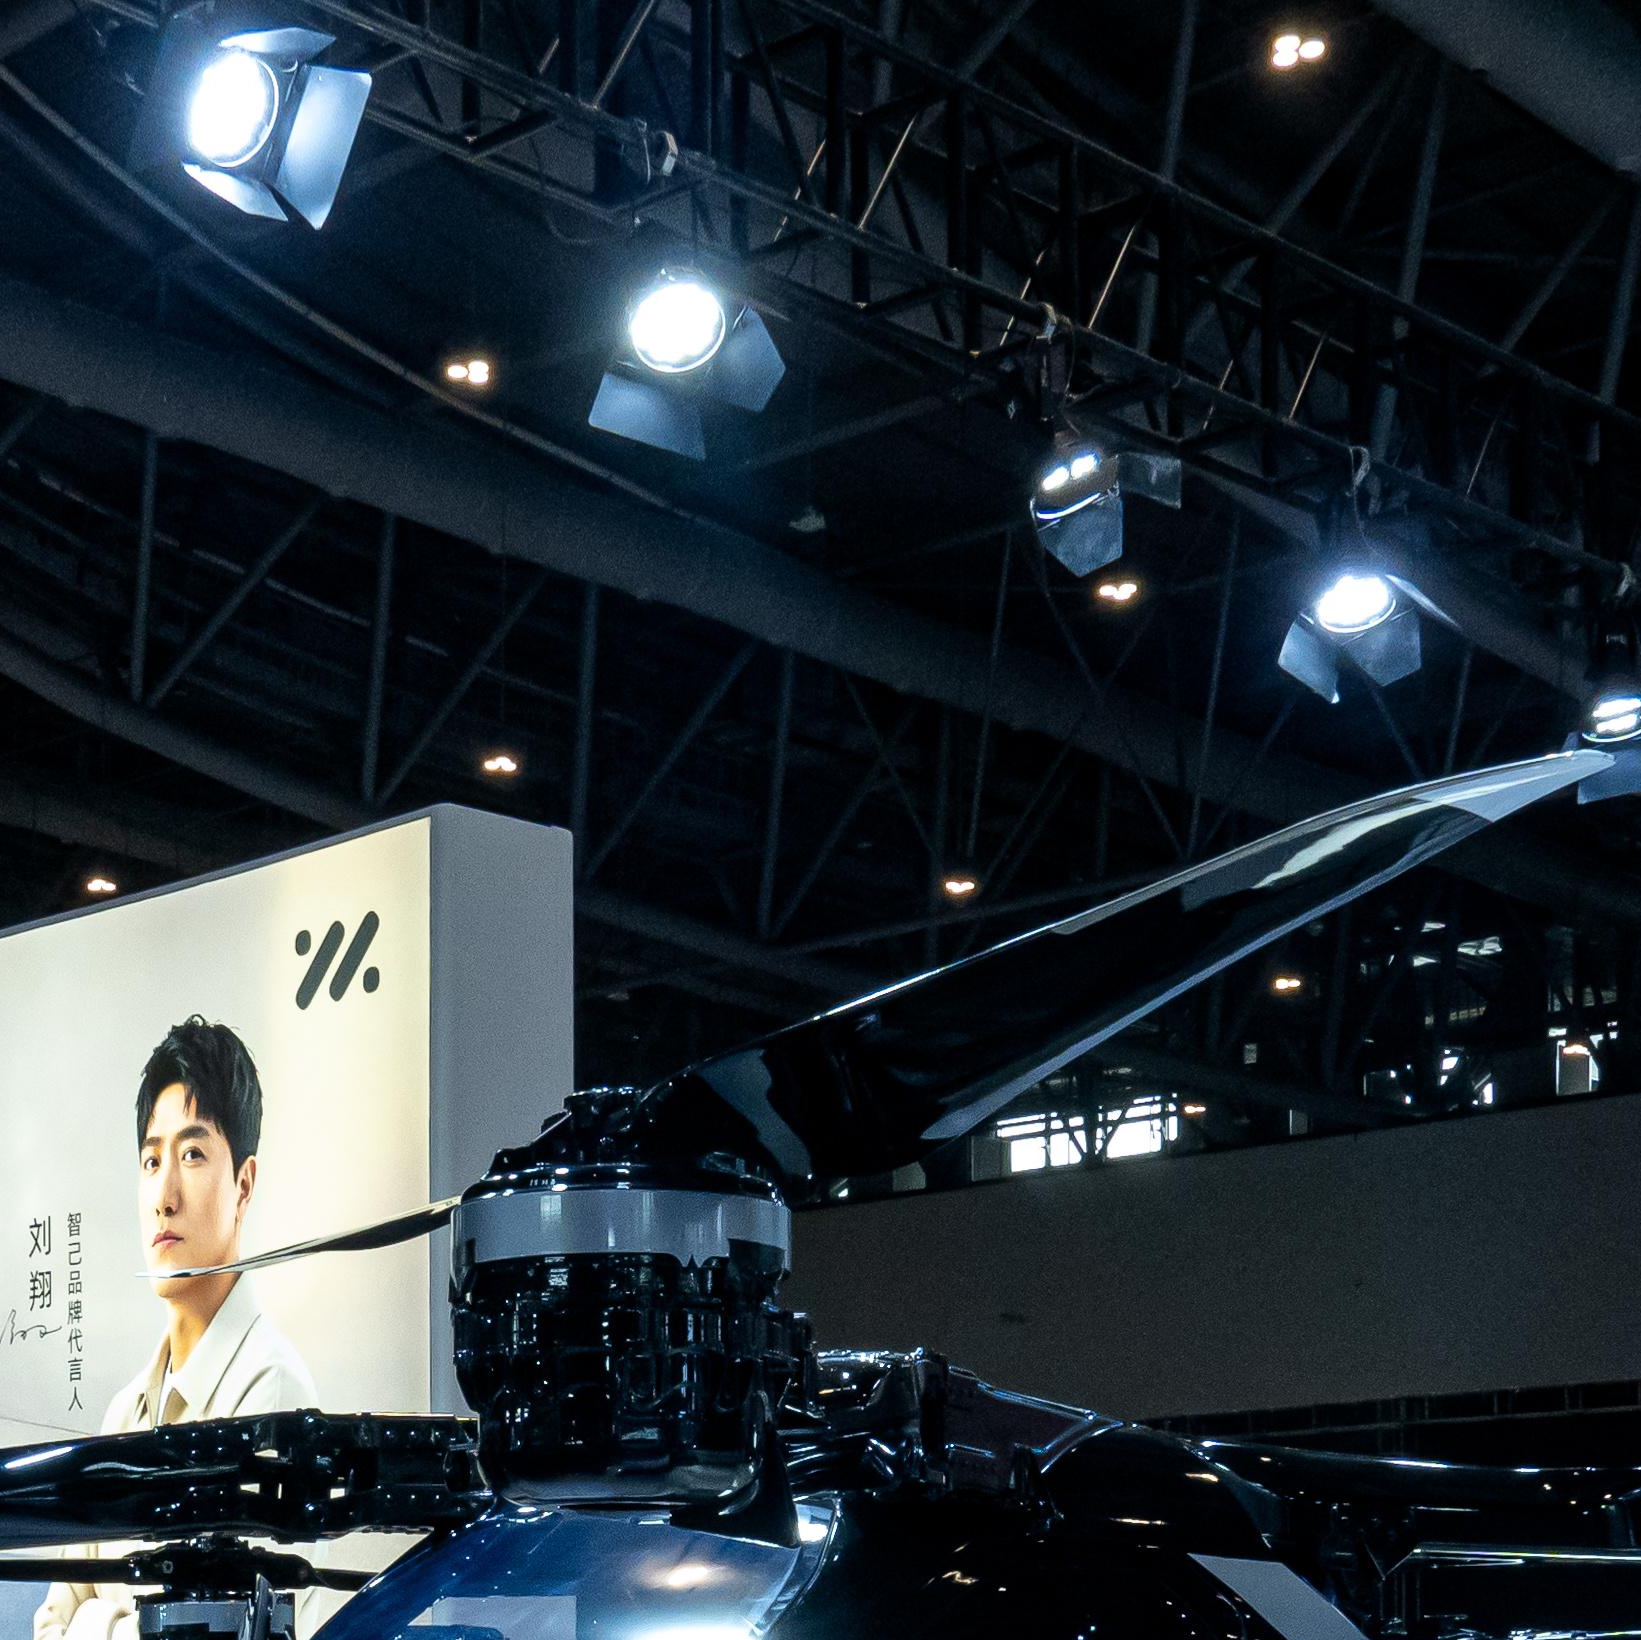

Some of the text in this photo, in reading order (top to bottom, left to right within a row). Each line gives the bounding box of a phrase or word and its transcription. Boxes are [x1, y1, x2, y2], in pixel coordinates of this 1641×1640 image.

[28, 1215, 52, 1312] 刘翔
[66, 1212, 84, 1412] 智己品牌代言人
